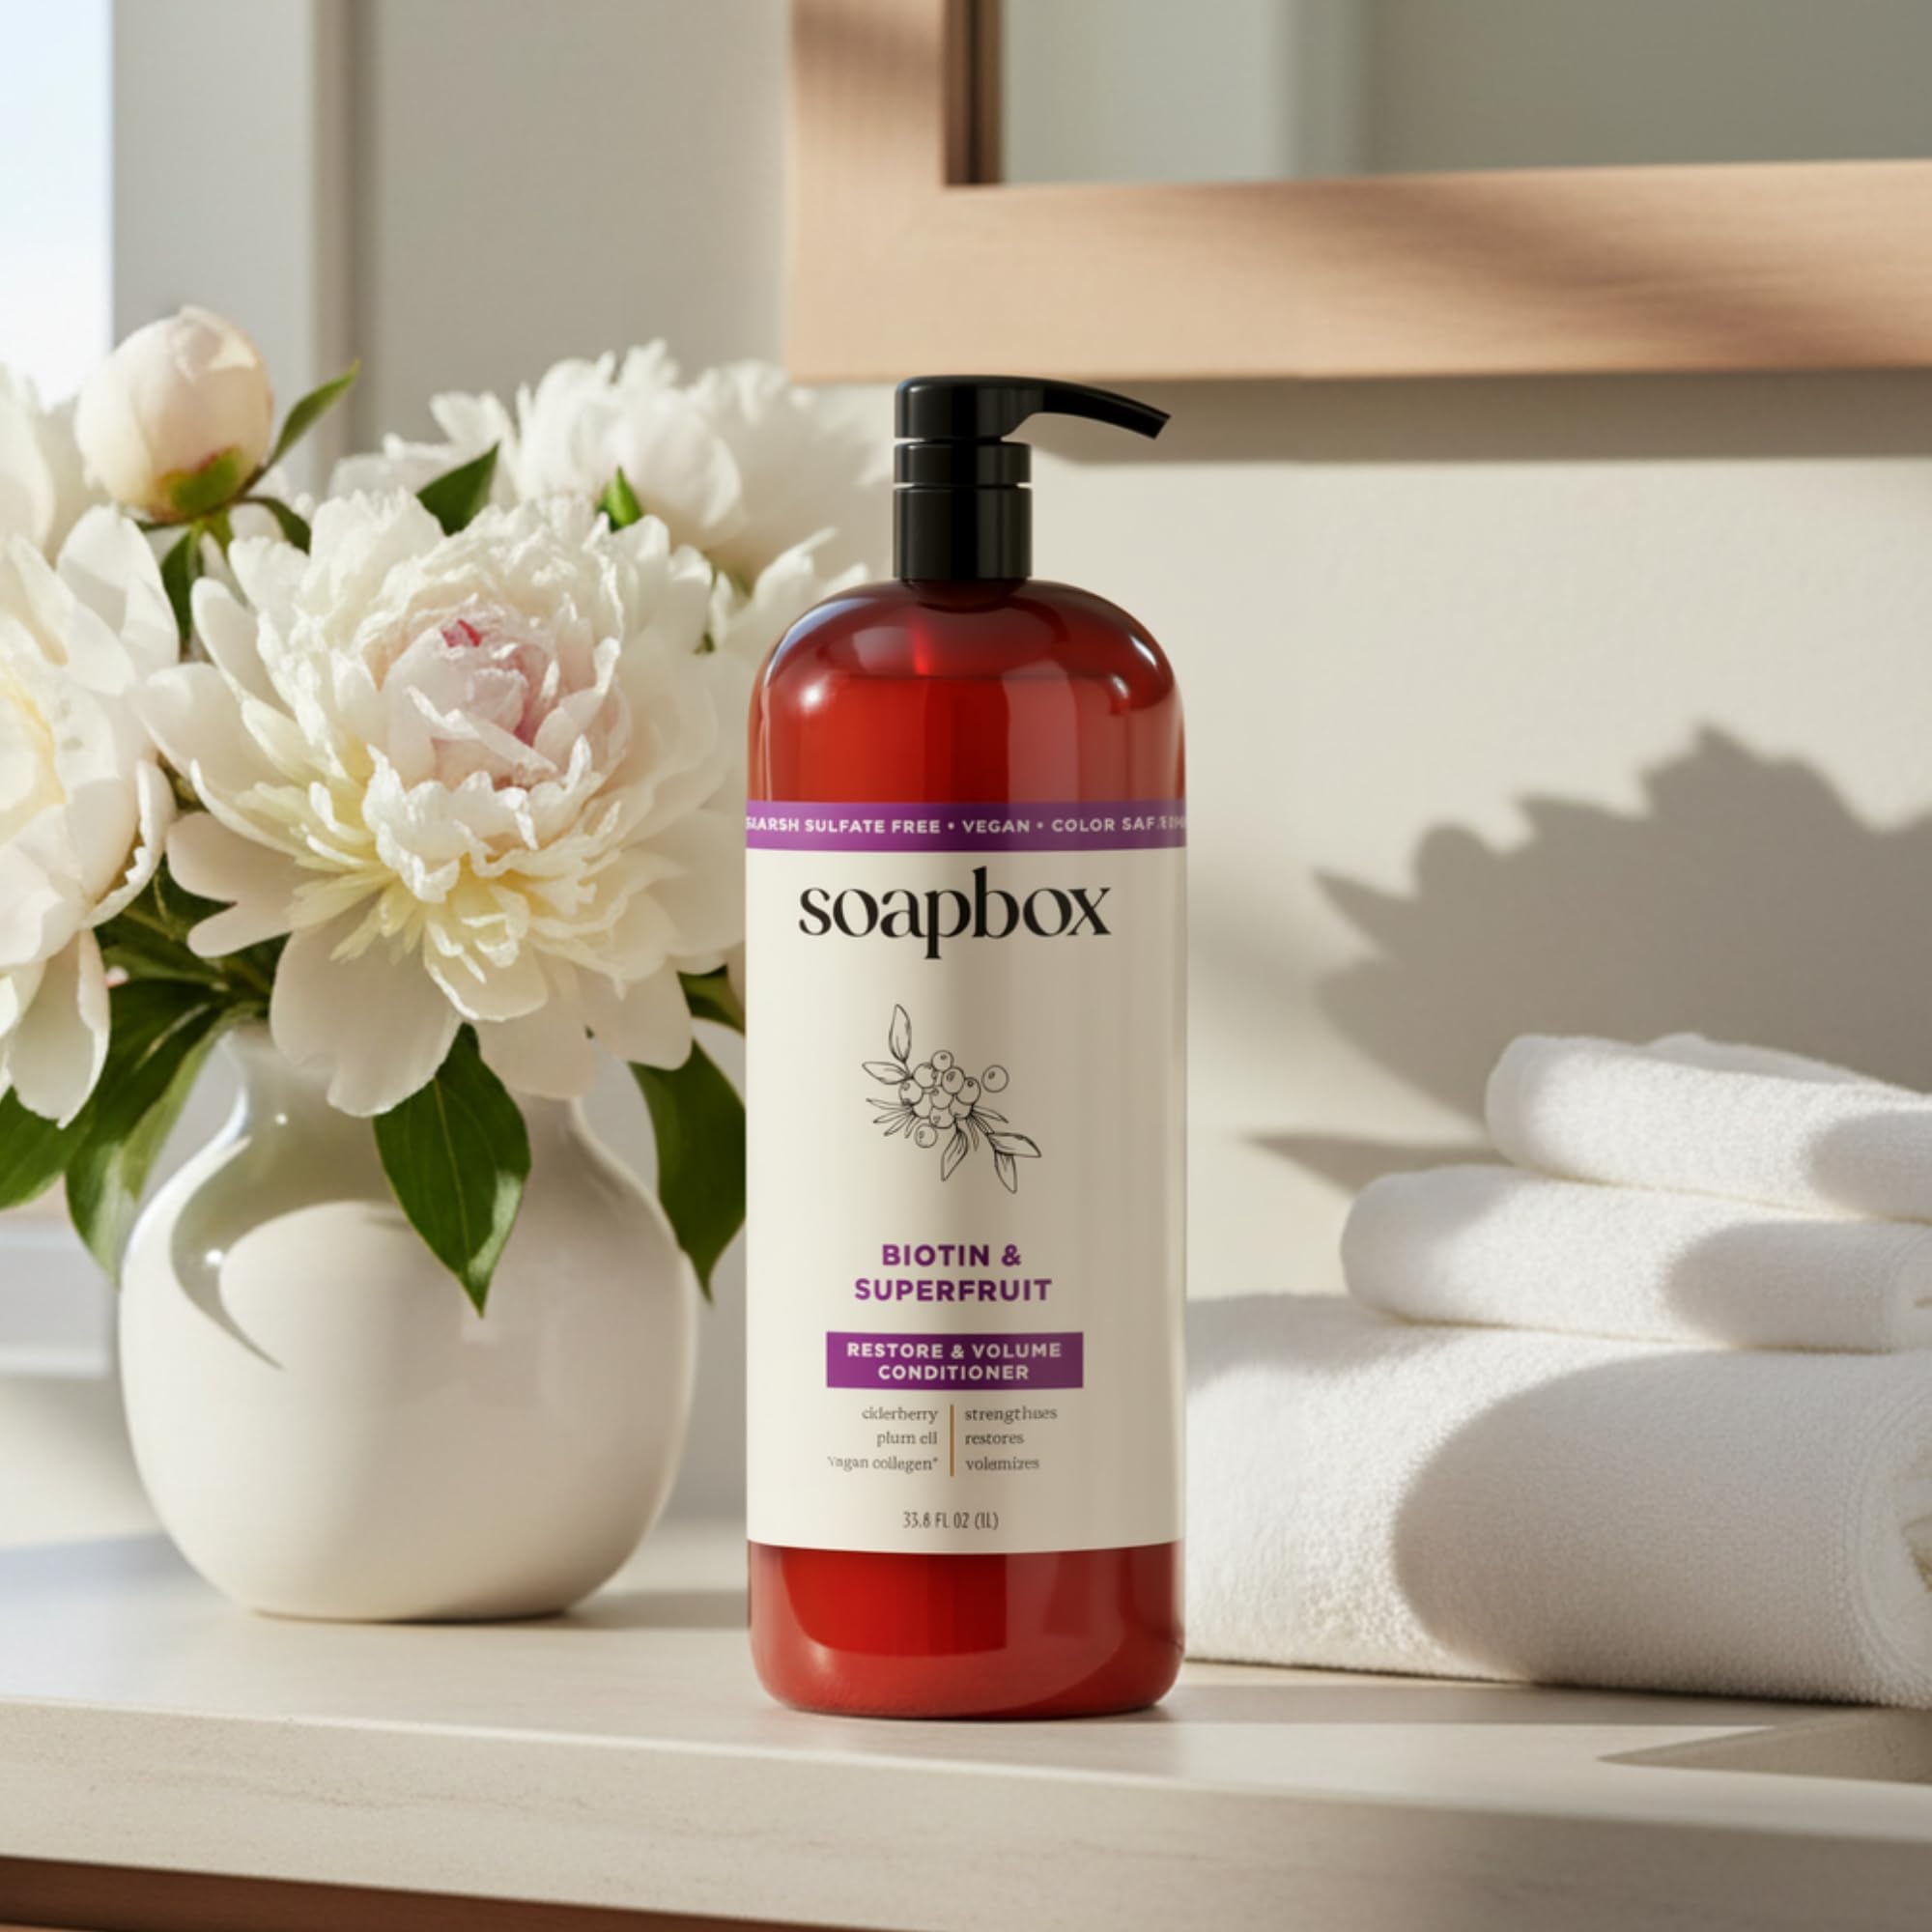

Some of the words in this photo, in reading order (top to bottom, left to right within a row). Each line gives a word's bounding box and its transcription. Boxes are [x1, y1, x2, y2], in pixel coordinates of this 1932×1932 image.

[805, 819, 886, 834] SULFATE
[892, 820, 941, 834] FREE
[962, 819, 1031, 833] VEGAN
[1051, 818, 1116, 833] COLOR
[799, 867, 1111, 959] soapbox
[882, 1244, 989, 1266] BIOTIN
[1001, 1243, 1022, 1266] &
[854, 1278, 1052, 1301] SUPERFRUIT
[846, 1342, 944, 1358] RESTORE
[950, 1344, 965, 1359] &
[971, 1342, 1062, 1358] VOLUME
[877, 1365, 1030, 1380] CONDITIONER
[877, 1432, 916, 1448] plum
[965, 1433, 1024, 1445] restores
[935, 1511, 950, 1529] FL
